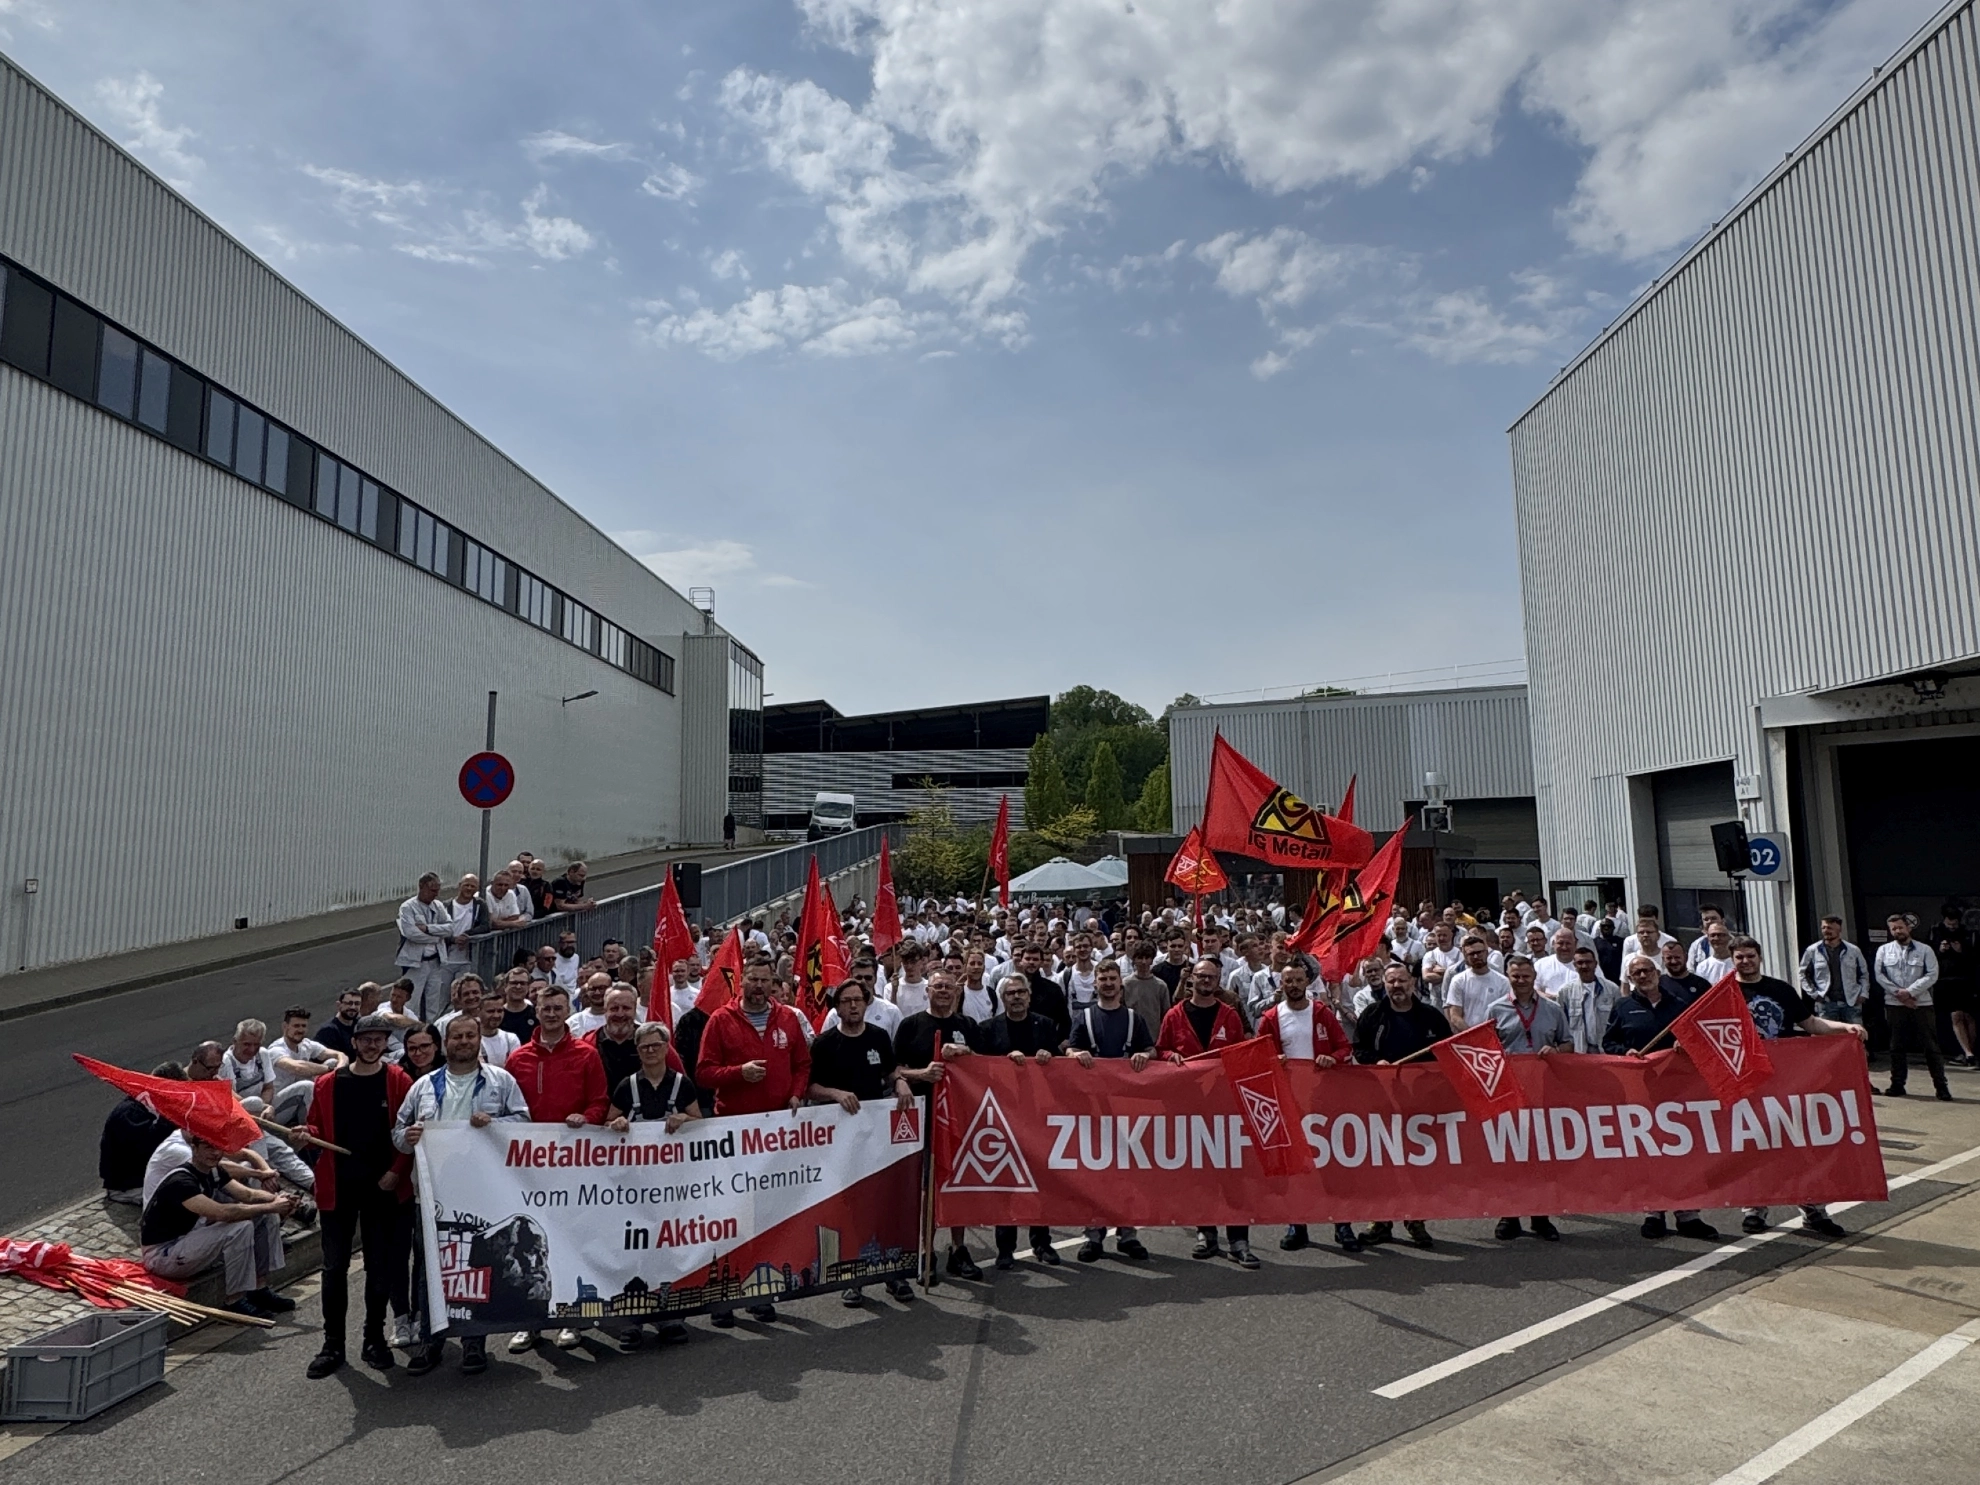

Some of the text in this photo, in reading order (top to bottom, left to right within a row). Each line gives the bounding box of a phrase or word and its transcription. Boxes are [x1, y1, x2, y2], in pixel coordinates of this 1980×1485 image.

[1248, 830, 1333, 860] IG Metall
[1751, 848, 1776, 866] 02
[505, 1120, 836, 1168] Metallerinnen und Metaller
[1047, 1089, 1867, 1171] ZUKUNF SONST WIDERSTAND!
[521, 1163, 823, 1207] vom Motorenwerk Chemnitz
[624, 1214, 737, 1251] in Aktion
